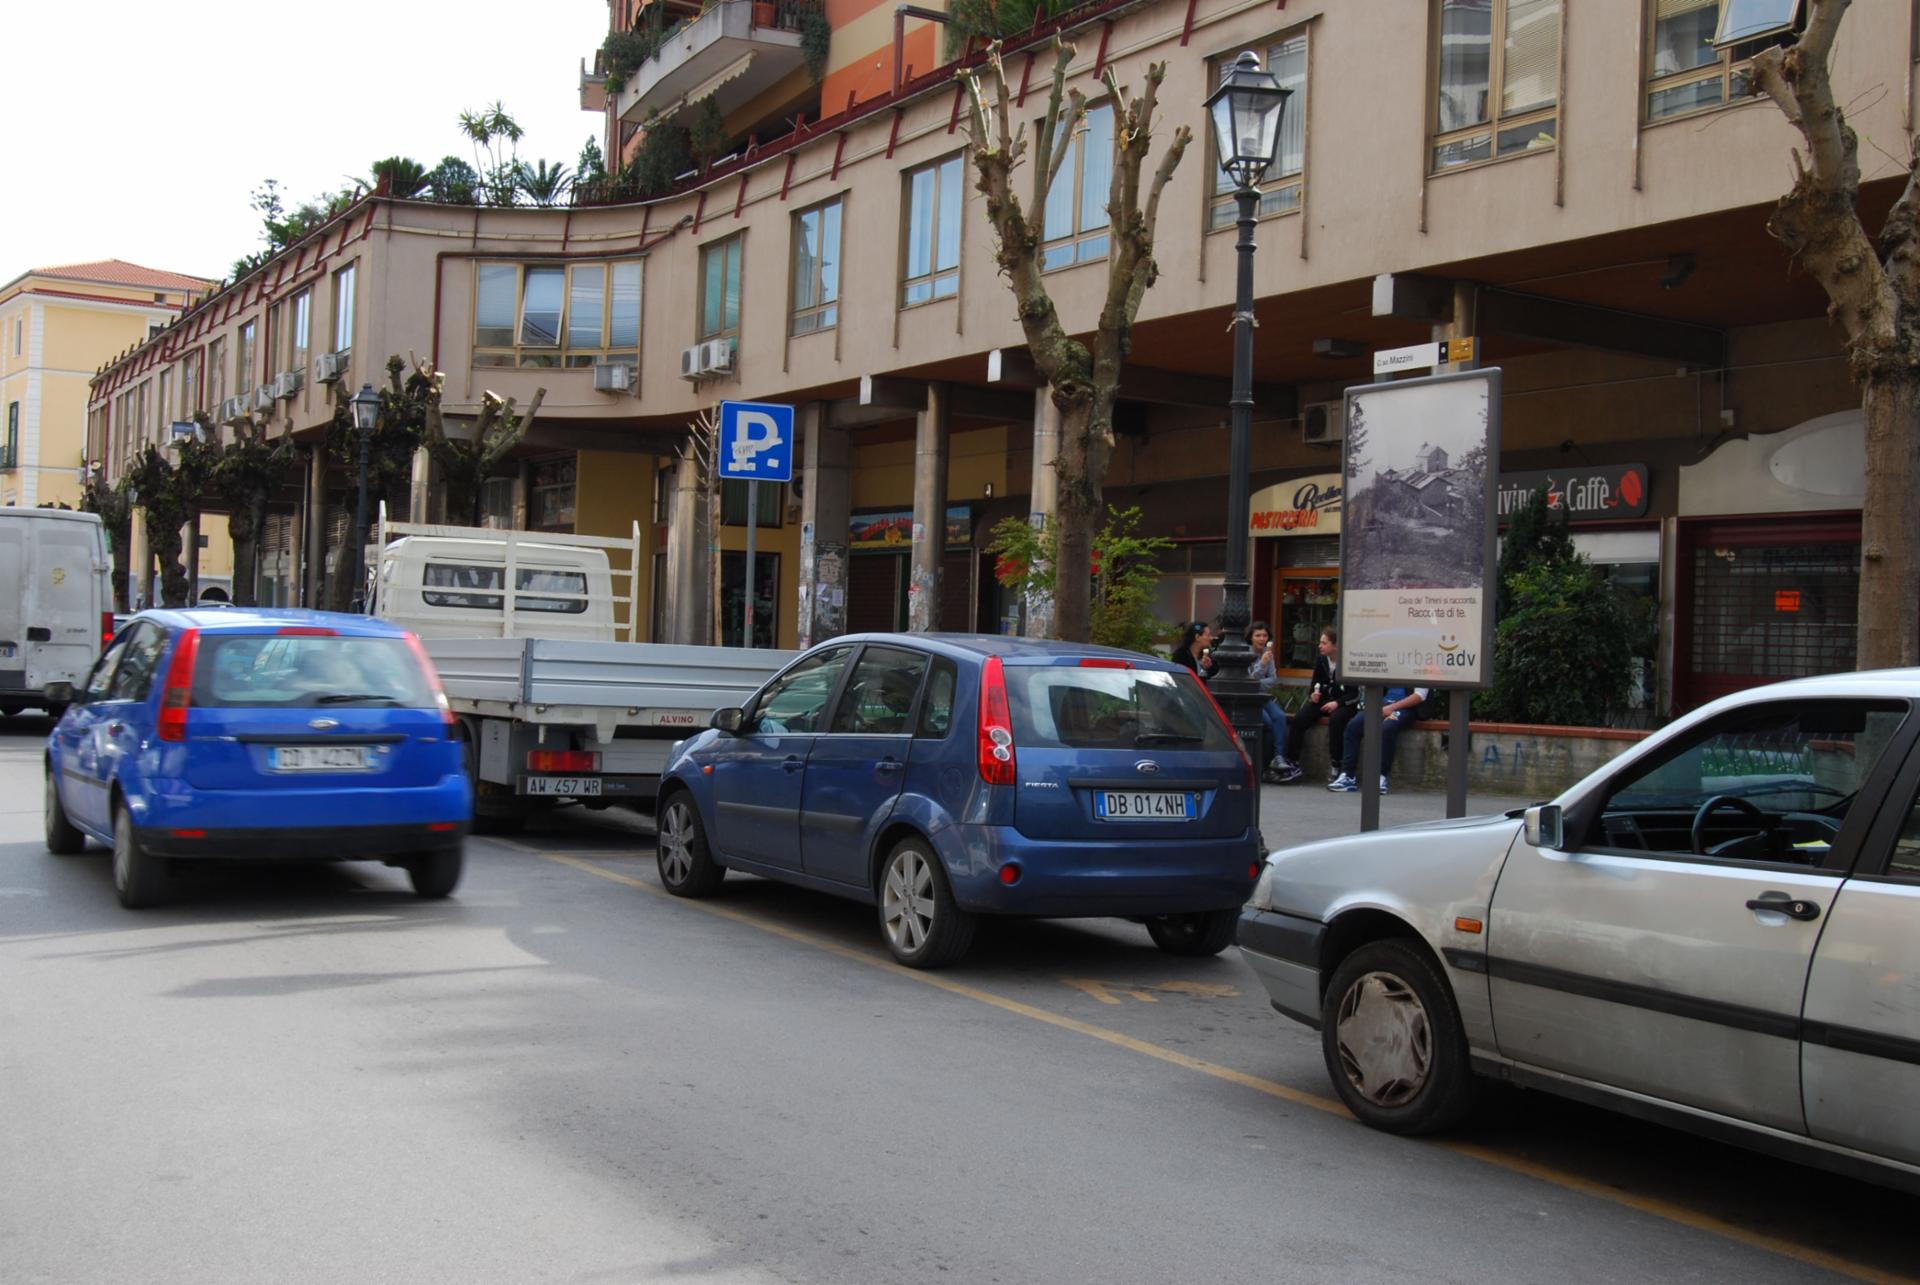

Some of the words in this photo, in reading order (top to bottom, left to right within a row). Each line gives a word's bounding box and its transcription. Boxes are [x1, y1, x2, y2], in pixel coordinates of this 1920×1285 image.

[1390, 354, 1413, 365] Mazzini
[1566, 477, 1609, 511] Caffè
[1250, 509, 1318, 530] PASTICCERIA
[1446, 607, 1455, 618] di
[1397, 649, 1476, 667] urbanadv
[659, 715, 694, 724] ALVINO
[530, 778, 546, 793] AW
[554, 779, 578, 794] 457
[583, 780, 600, 794] WR
[1107, 793, 1128, 815] DB
[1134, 794, 1185, 816] 014NH
